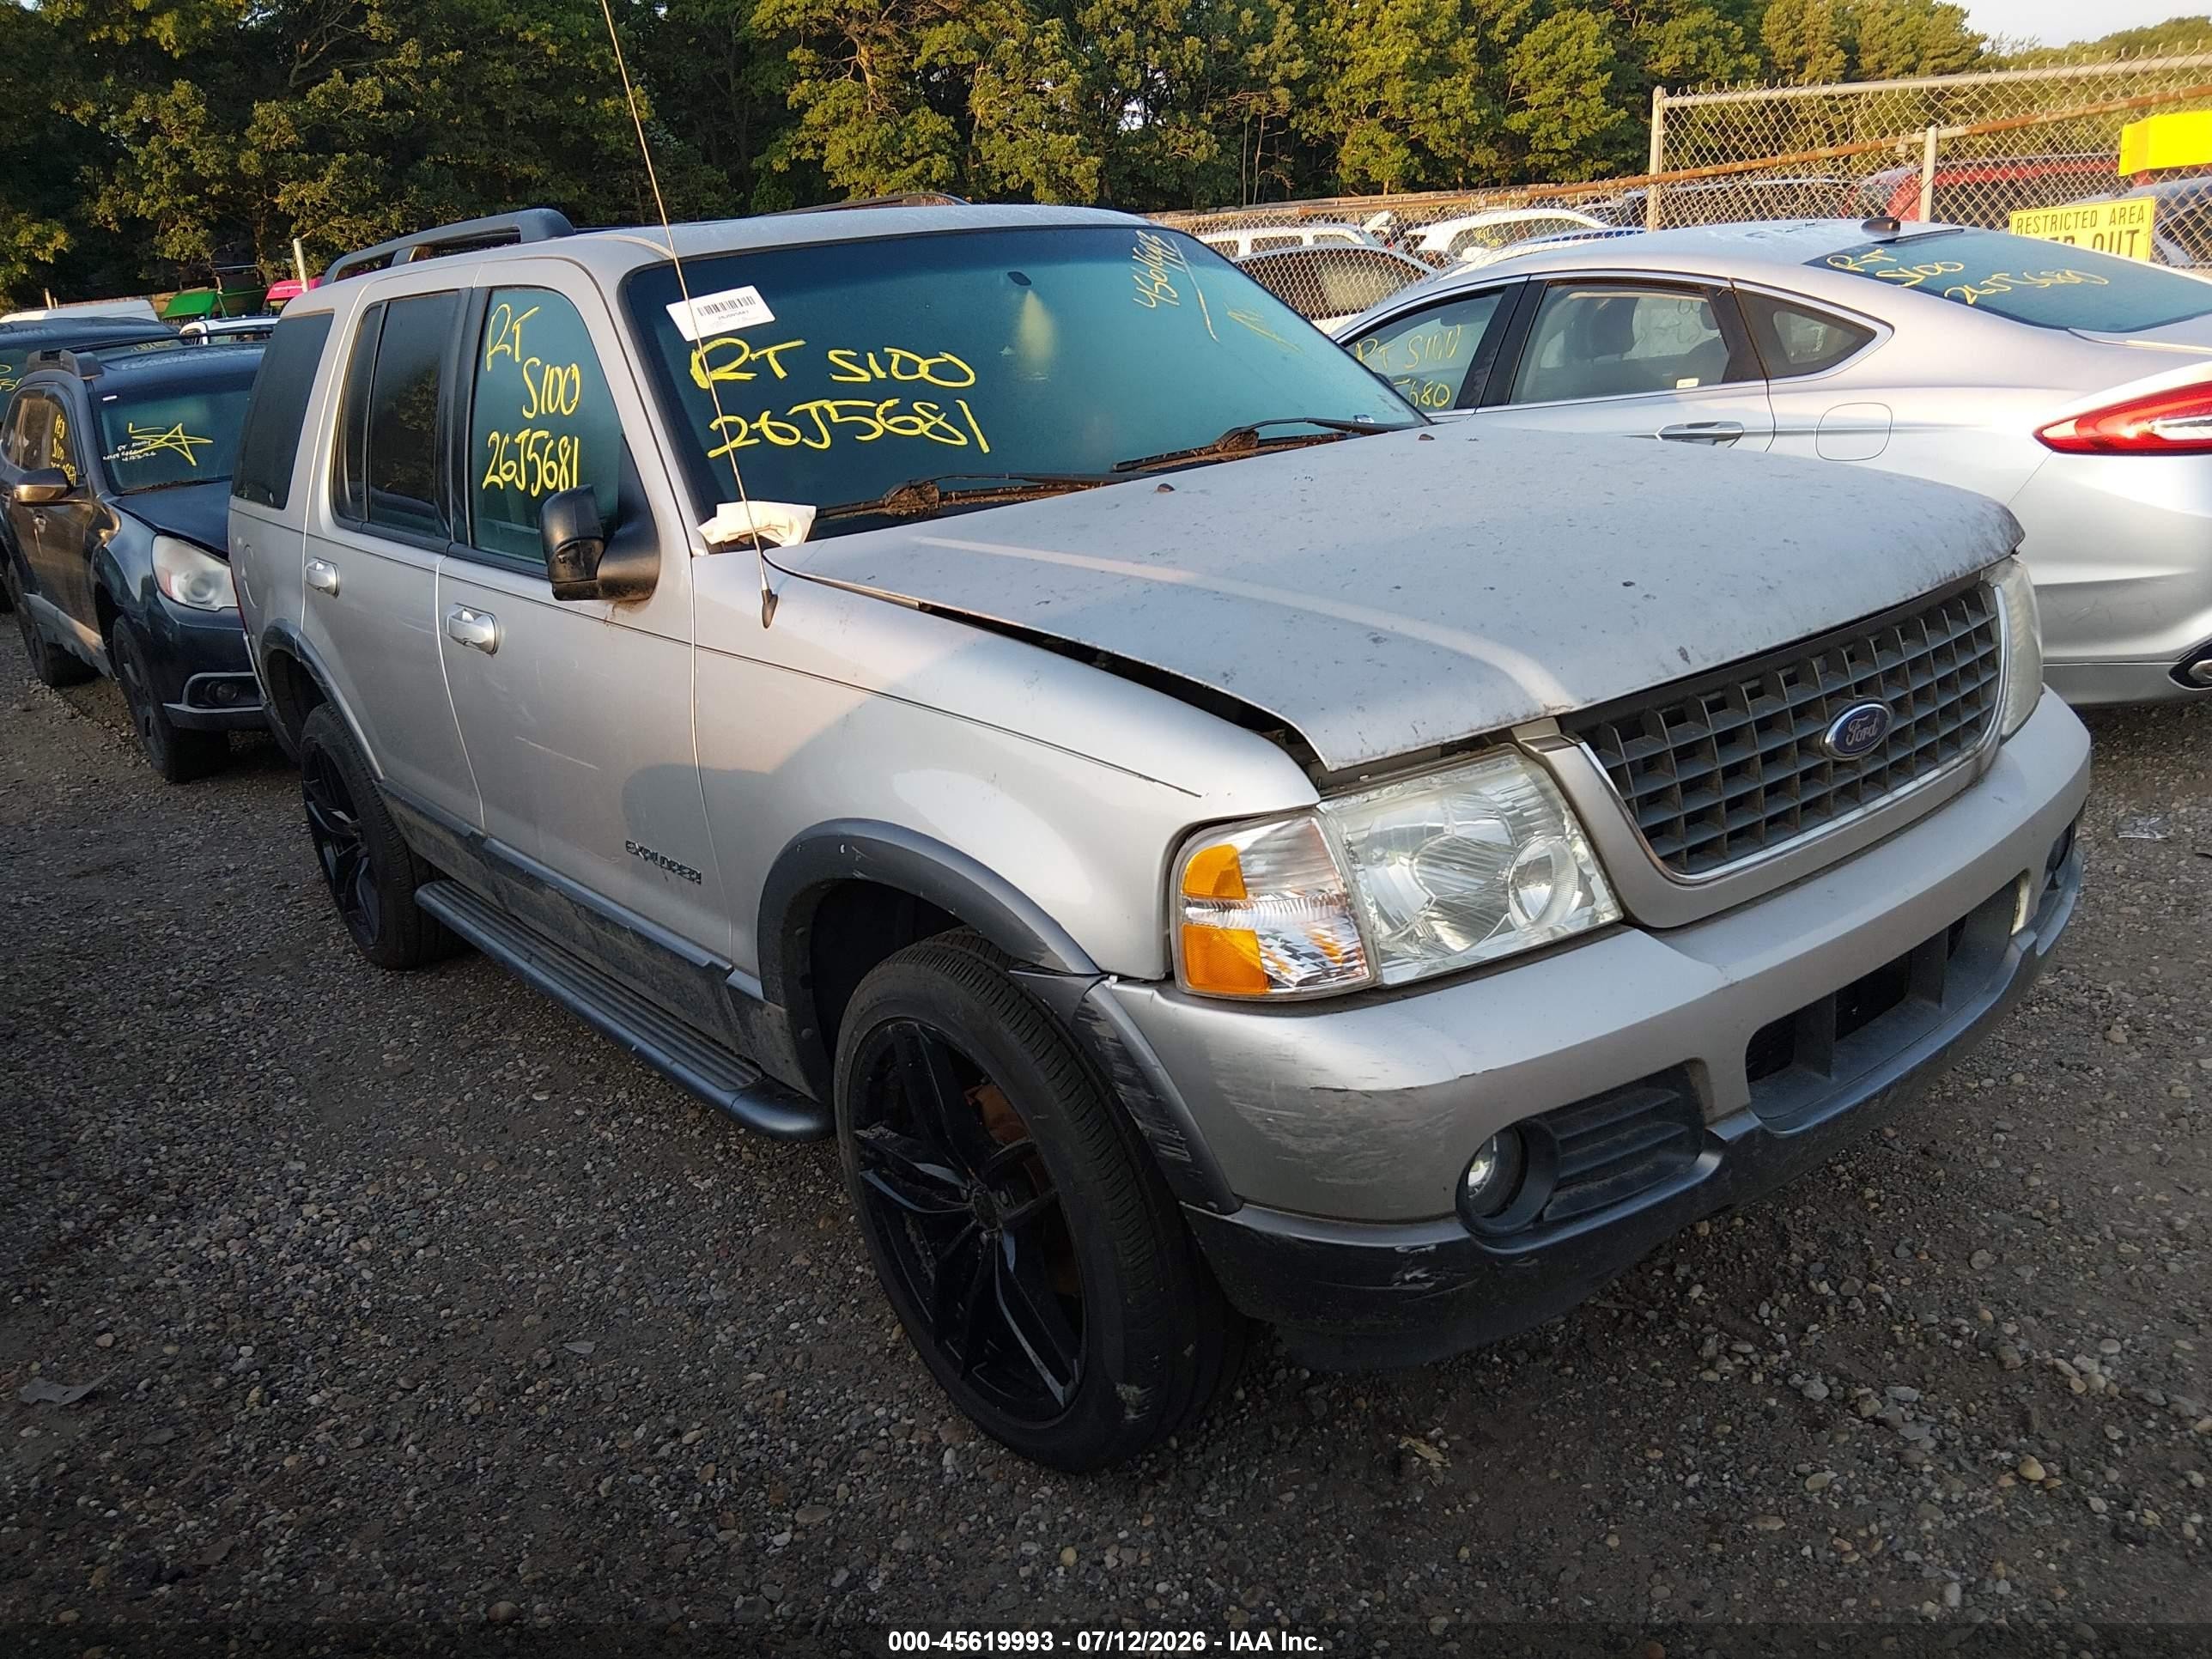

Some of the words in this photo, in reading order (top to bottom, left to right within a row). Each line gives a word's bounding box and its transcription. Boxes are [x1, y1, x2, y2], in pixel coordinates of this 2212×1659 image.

[2015, 210, 2098, 235] RESTRICTED
[2108, 204, 2144, 227] AREA
[1826, 248, 1897, 272] RT
[486, 303, 540, 372] RT
[690, 337, 806, 390] RT
[827, 347, 976, 387] S100
[1355, 337, 1395, 371] RT
[522, 356, 581, 419] S100
[706, 398, 991, 459] 26J5681
[482, 428, 580, 498] 26J5681
[1845, 714, 1879, 746] Ford
